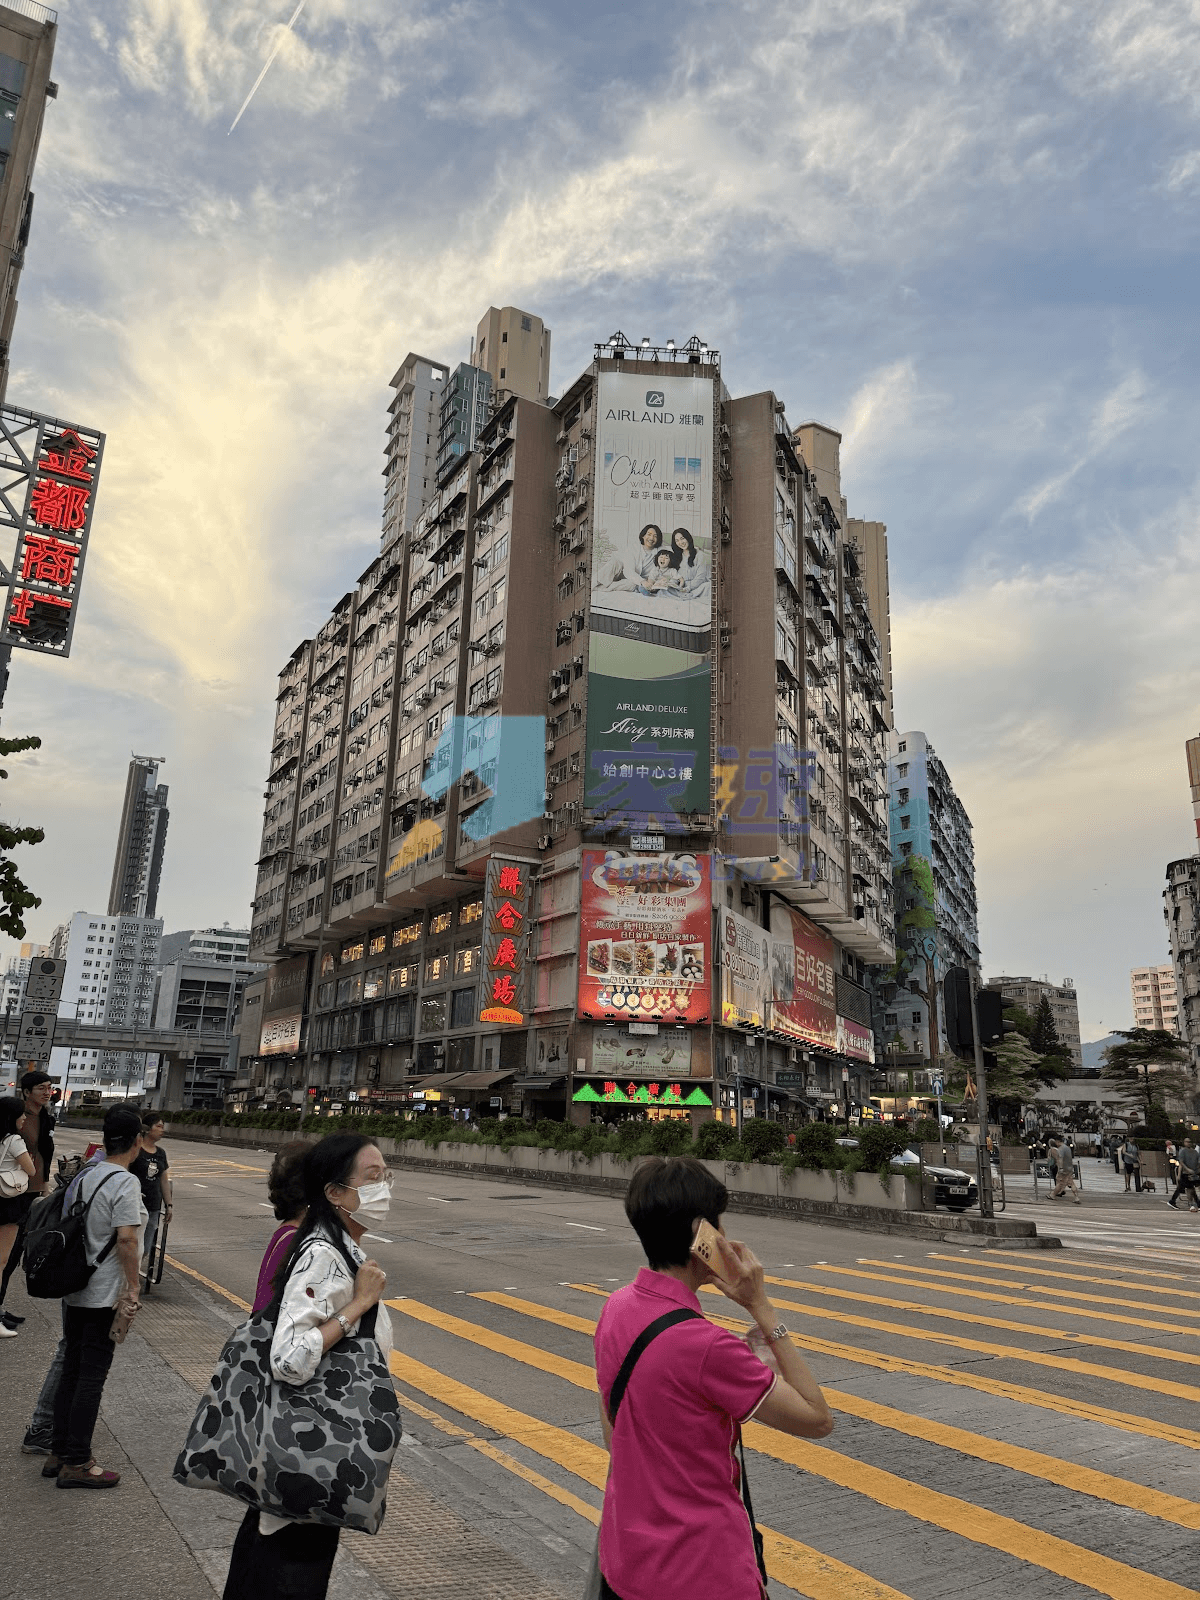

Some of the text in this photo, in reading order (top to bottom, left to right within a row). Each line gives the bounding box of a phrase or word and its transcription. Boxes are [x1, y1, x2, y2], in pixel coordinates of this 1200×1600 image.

[605, 409, 704, 426] AIRLAND 雅蘭
[610, 455, 657, 486] Chill
[629, 479, 696, 491] with AIRLAND
[629, 490, 696, 502] 超乎睡眠享受
[616, 703, 688, 714] AIRLAND DELUXE
[600, 717, 695, 743] Airy 系列床褥
[603, 763, 693, 781] 始創中心3樓
[637, 895, 687, 908] 好彩集團
[795, 945, 835, 997] 百好名宴
[50, 978, 57, 986] 7
[49, 989, 56, 997] 7
[37, 1052, 48, 1060] 12
[604, 1081, 681, 1097] 聯合廣場
